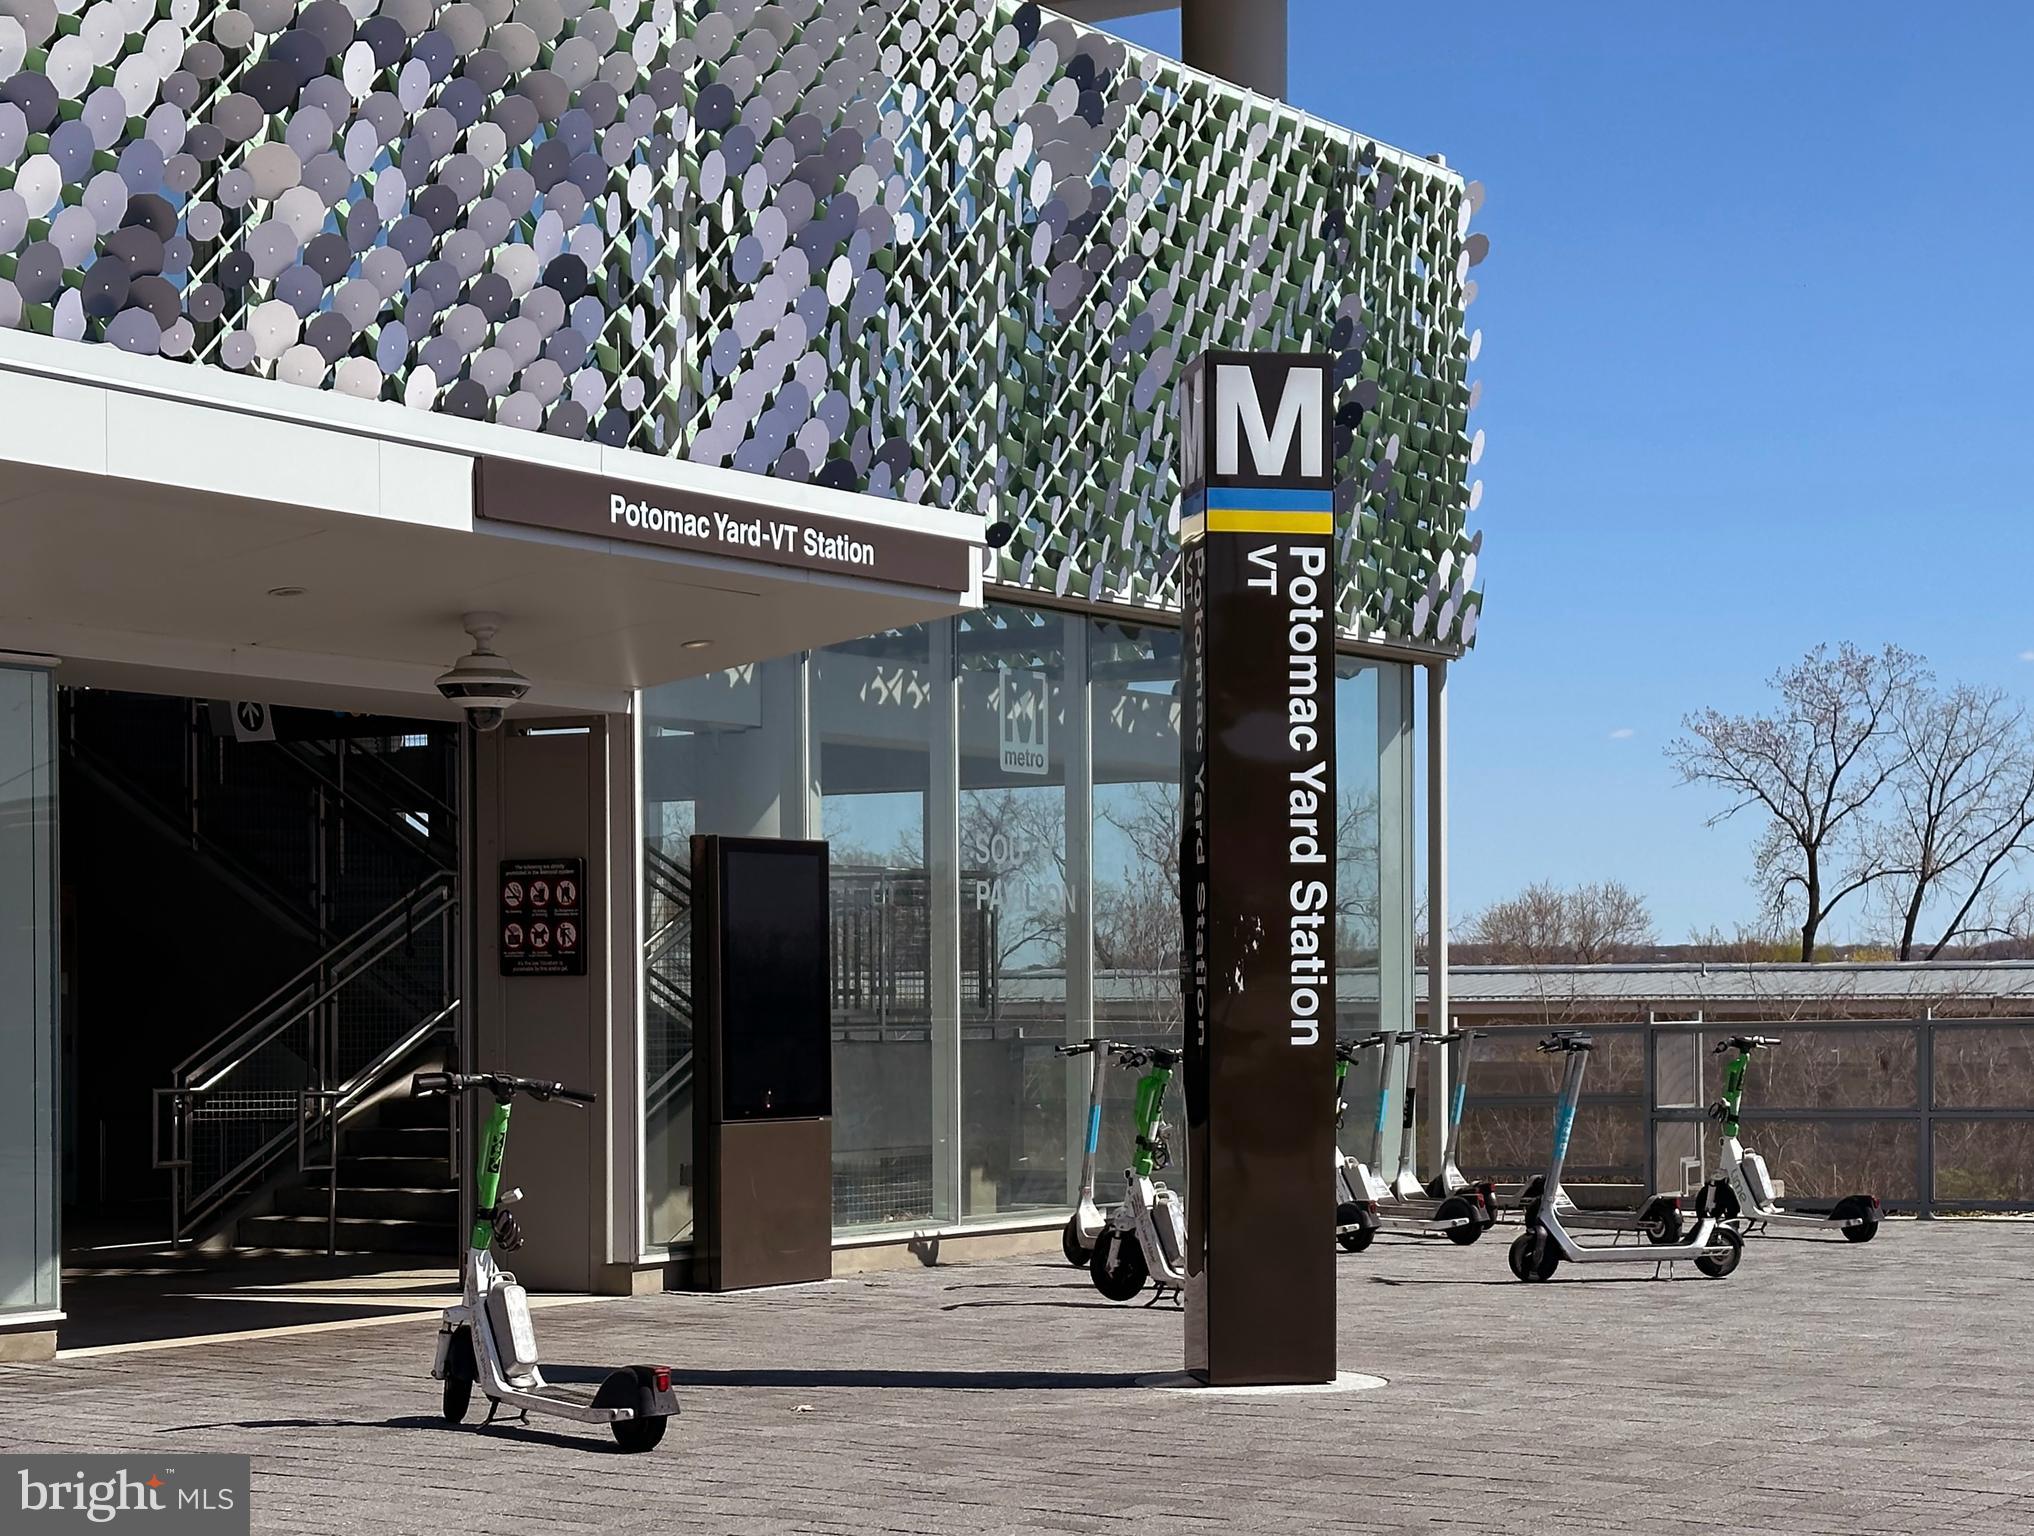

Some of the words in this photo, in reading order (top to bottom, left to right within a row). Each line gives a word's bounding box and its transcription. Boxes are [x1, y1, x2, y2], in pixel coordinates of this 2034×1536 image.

[1180, 368, 1203, 488] M
[1216, 365, 1323, 477] M
[609, 493, 710, 539] Potomac
[712, 512, 798, 552] Yard-VT
[803, 528, 874, 566] Station
[1247, 544, 1277, 595] VT
[1193, 547, 1205, 752] Potomac
[1289, 546, 1325, 751] Potomac
[1004, 749, 1044, 768] metro
[1289, 761, 1326, 863] Yard
[1194, 761, 1205, 864] Yard
[976, 881, 1076, 914] PALON
[1196, 882, 1206, 1046] Station
[1289, 880, 1328, 1046] Station
